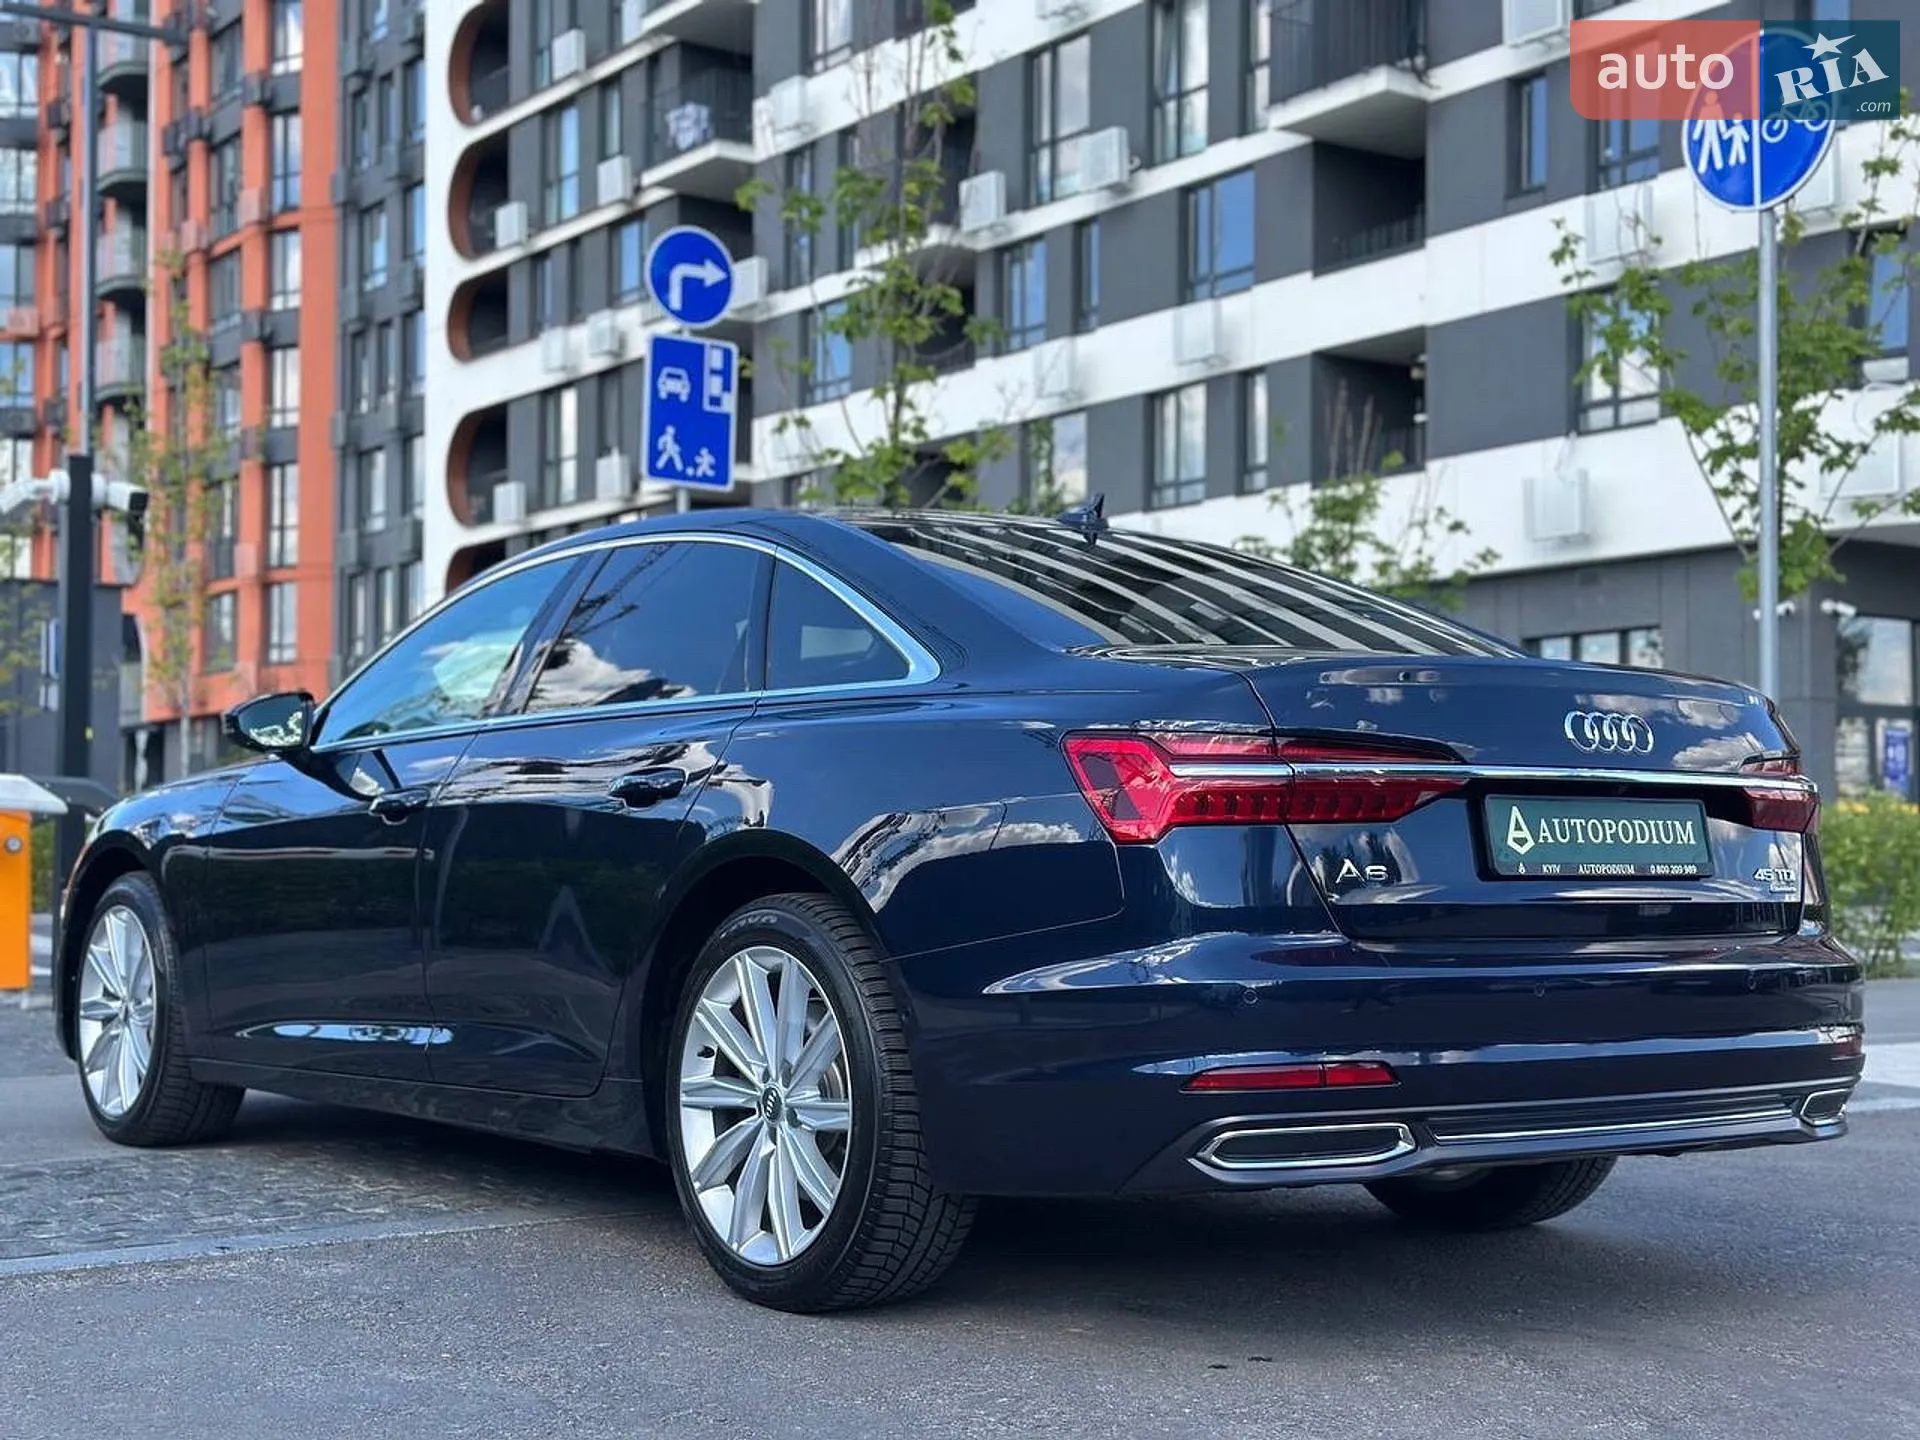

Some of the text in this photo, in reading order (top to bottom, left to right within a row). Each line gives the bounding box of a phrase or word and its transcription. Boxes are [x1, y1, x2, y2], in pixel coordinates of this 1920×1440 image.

[1538, 818, 1696, 845] AUTOPODIUM
[1335, 858, 1389, 884] A6
[1542, 863, 1561, 875] KYIV
[1577, 863, 1635, 875] AUTOPODIUM
